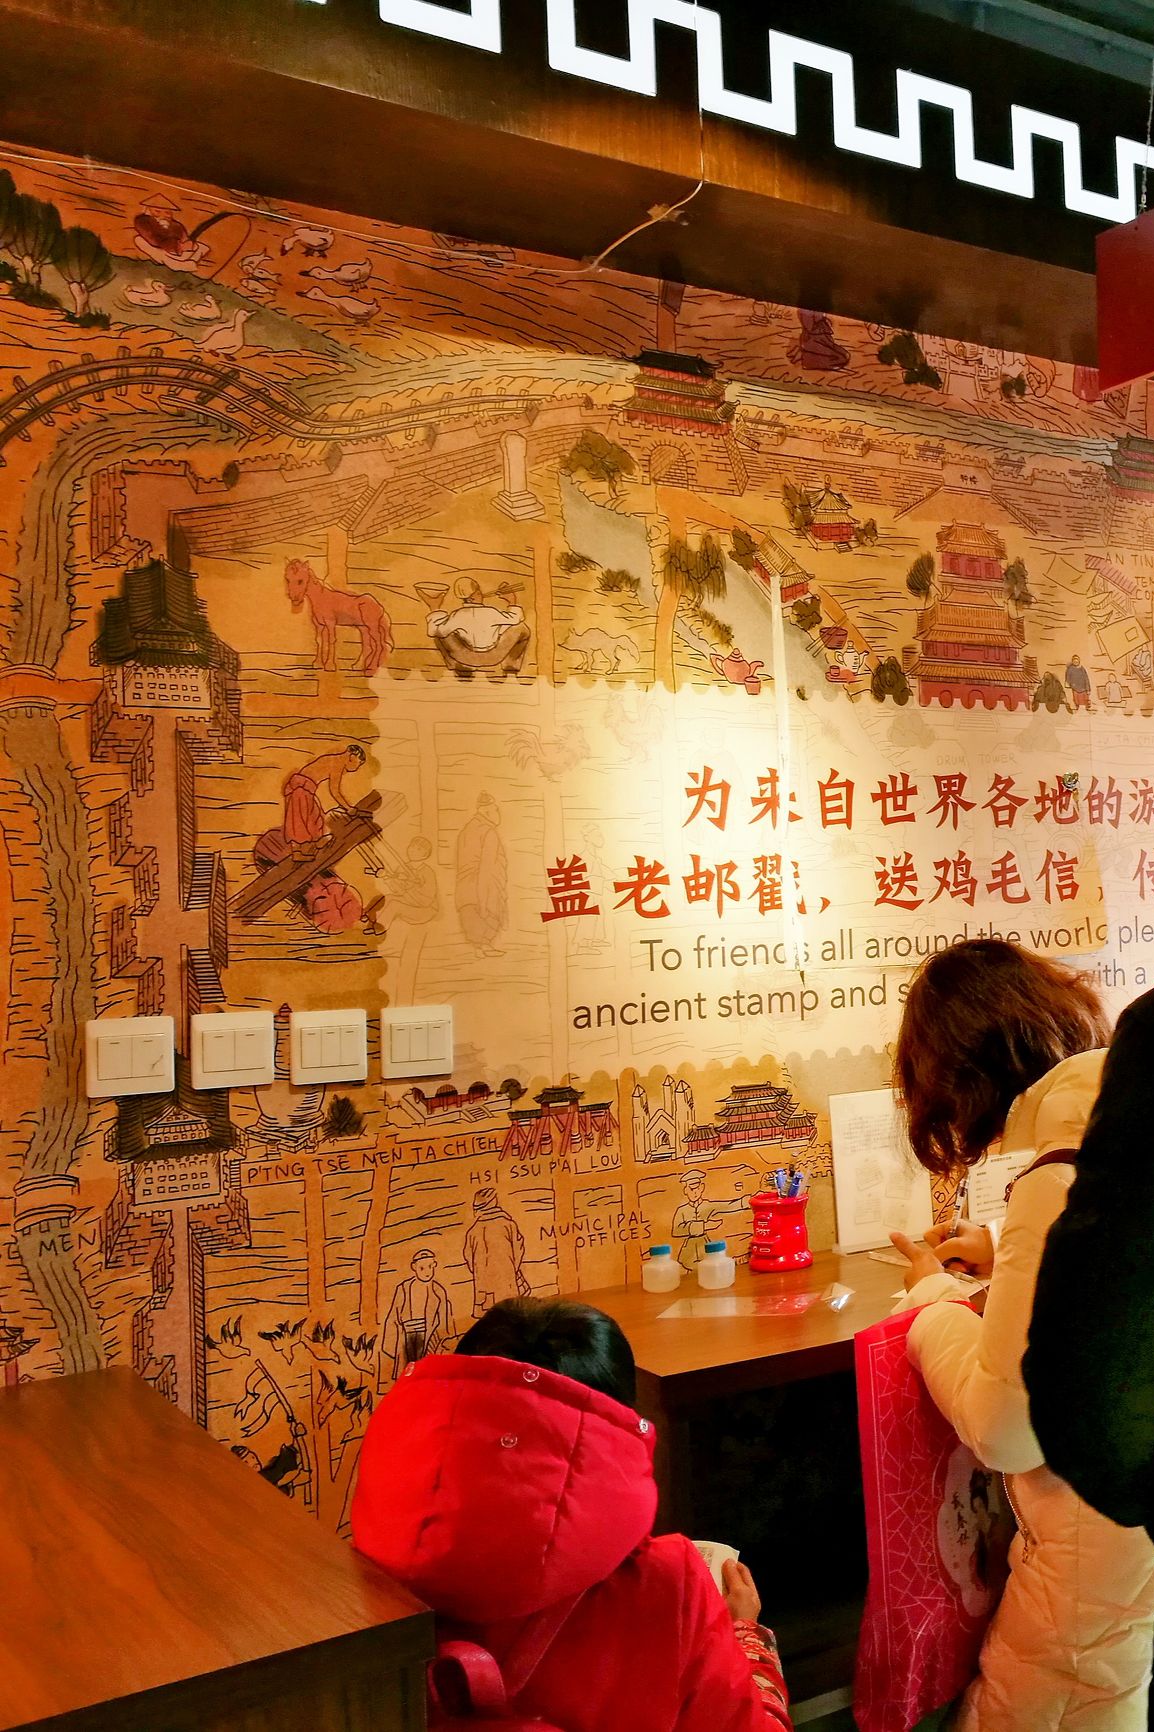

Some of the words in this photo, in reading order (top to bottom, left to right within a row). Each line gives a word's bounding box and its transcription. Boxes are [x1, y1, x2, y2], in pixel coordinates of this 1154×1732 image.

[639, 938, 683, 972] To
[820, 928, 853, 962] all
[1134, 965, 1147, 985] a
[572, 991, 708, 1030] ancient
[717, 989, 820, 1021] stamp
[830, 973, 887, 1009] and
[311, 1154, 351, 1175] TSE
[362, 1146, 403, 1168] MEN
[410, 1145, 437, 1164] TA
[443, 1136, 498, 1156] CHIEH
[469, 1168, 499, 1185] HSI
[509, 1164, 541, 1179] SSU
[590, 1153, 620, 1169] LOU
[539, 1210, 650, 1241] MUNICIPAL
[574, 1224, 652, 1248] OFFICES
[38, 1227, 97, 1258] MEN
